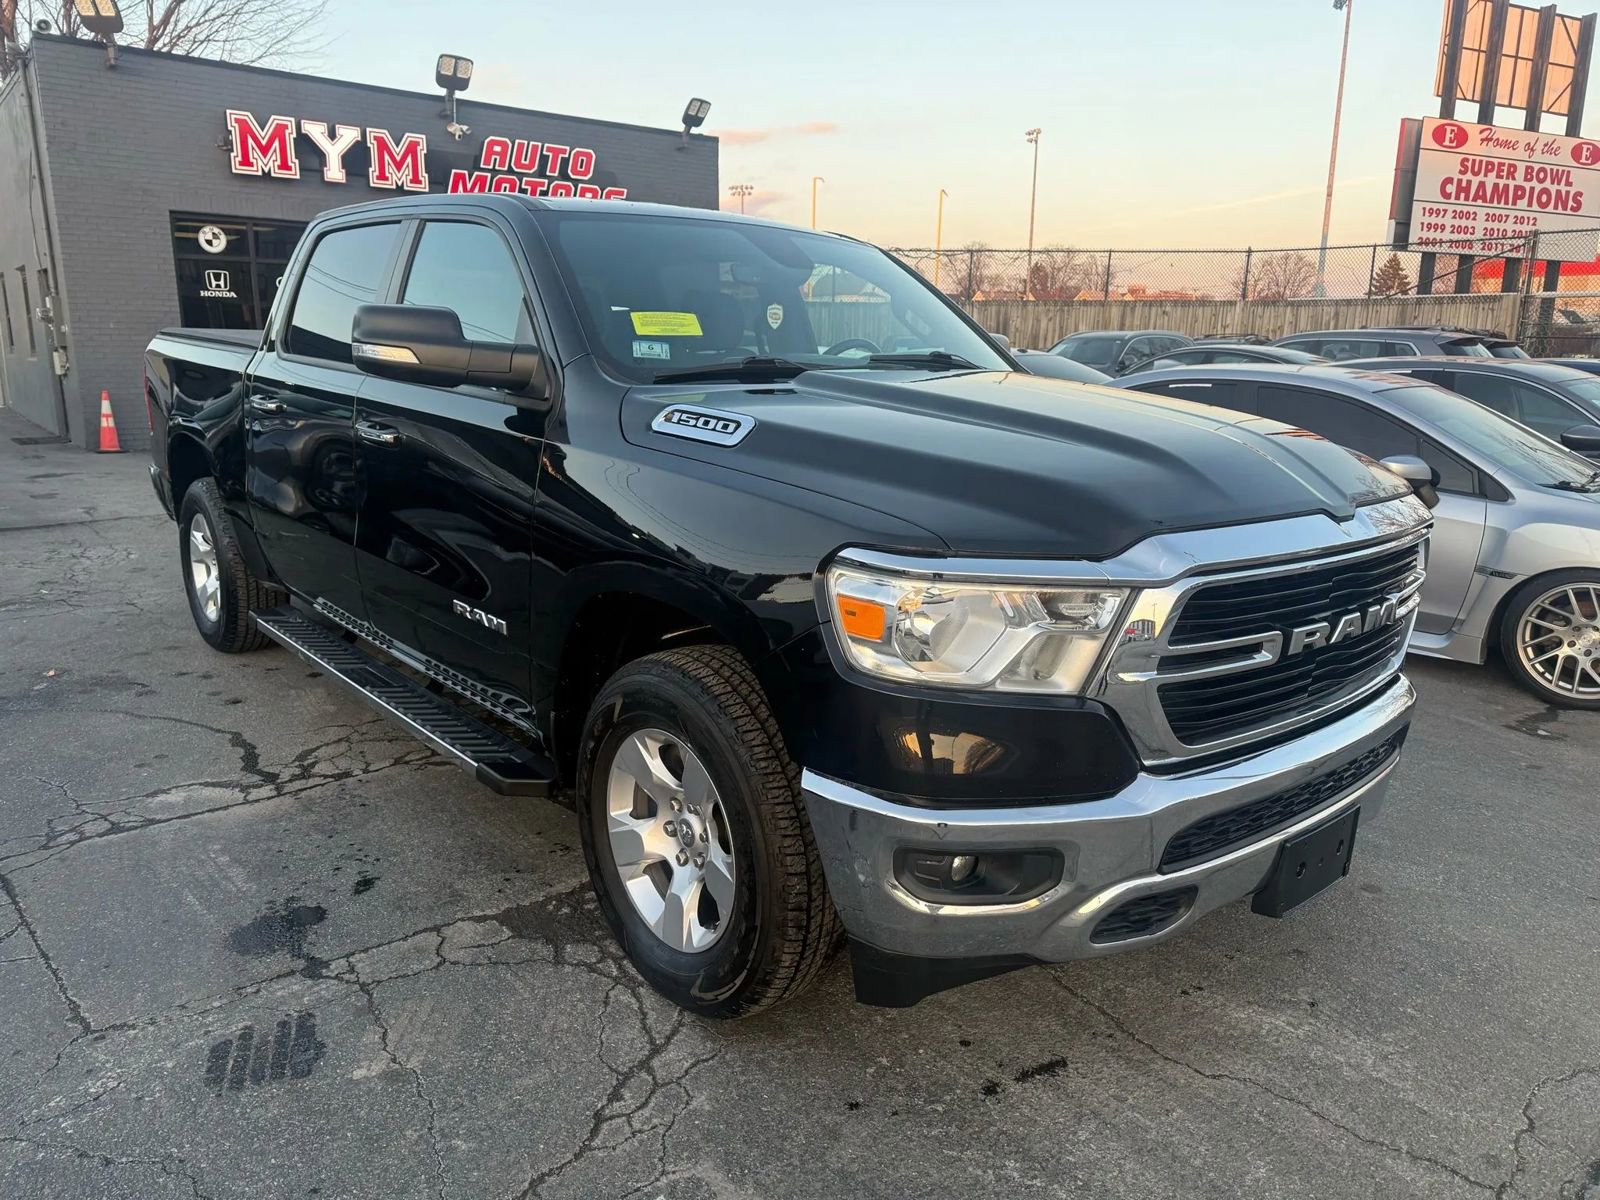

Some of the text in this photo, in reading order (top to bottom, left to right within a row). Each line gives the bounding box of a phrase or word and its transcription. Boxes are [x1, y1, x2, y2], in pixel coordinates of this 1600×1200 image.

[225, 109, 429, 192] MYM
[1442, 125, 1458, 147] E
[1479, 127, 1561, 158] Home of the
[480, 136, 596, 180] AUTO
[1458, 157, 1573, 187] SUPER BOWL
[1440, 176, 1584, 213] CHAMPIONS
[1420, 222, 1446, 233] 1999
[1449, 224, 1476, 235] 2003
[1482, 227, 1508, 239] 2010
[1421, 207, 1538, 226] 1997 2002 2007 2012
[200, 290, 238, 298] HONDA
[671, 412, 738, 433] 1500
[453, 599, 507, 636] RAM
[1287, 597, 1398, 656] RAM
